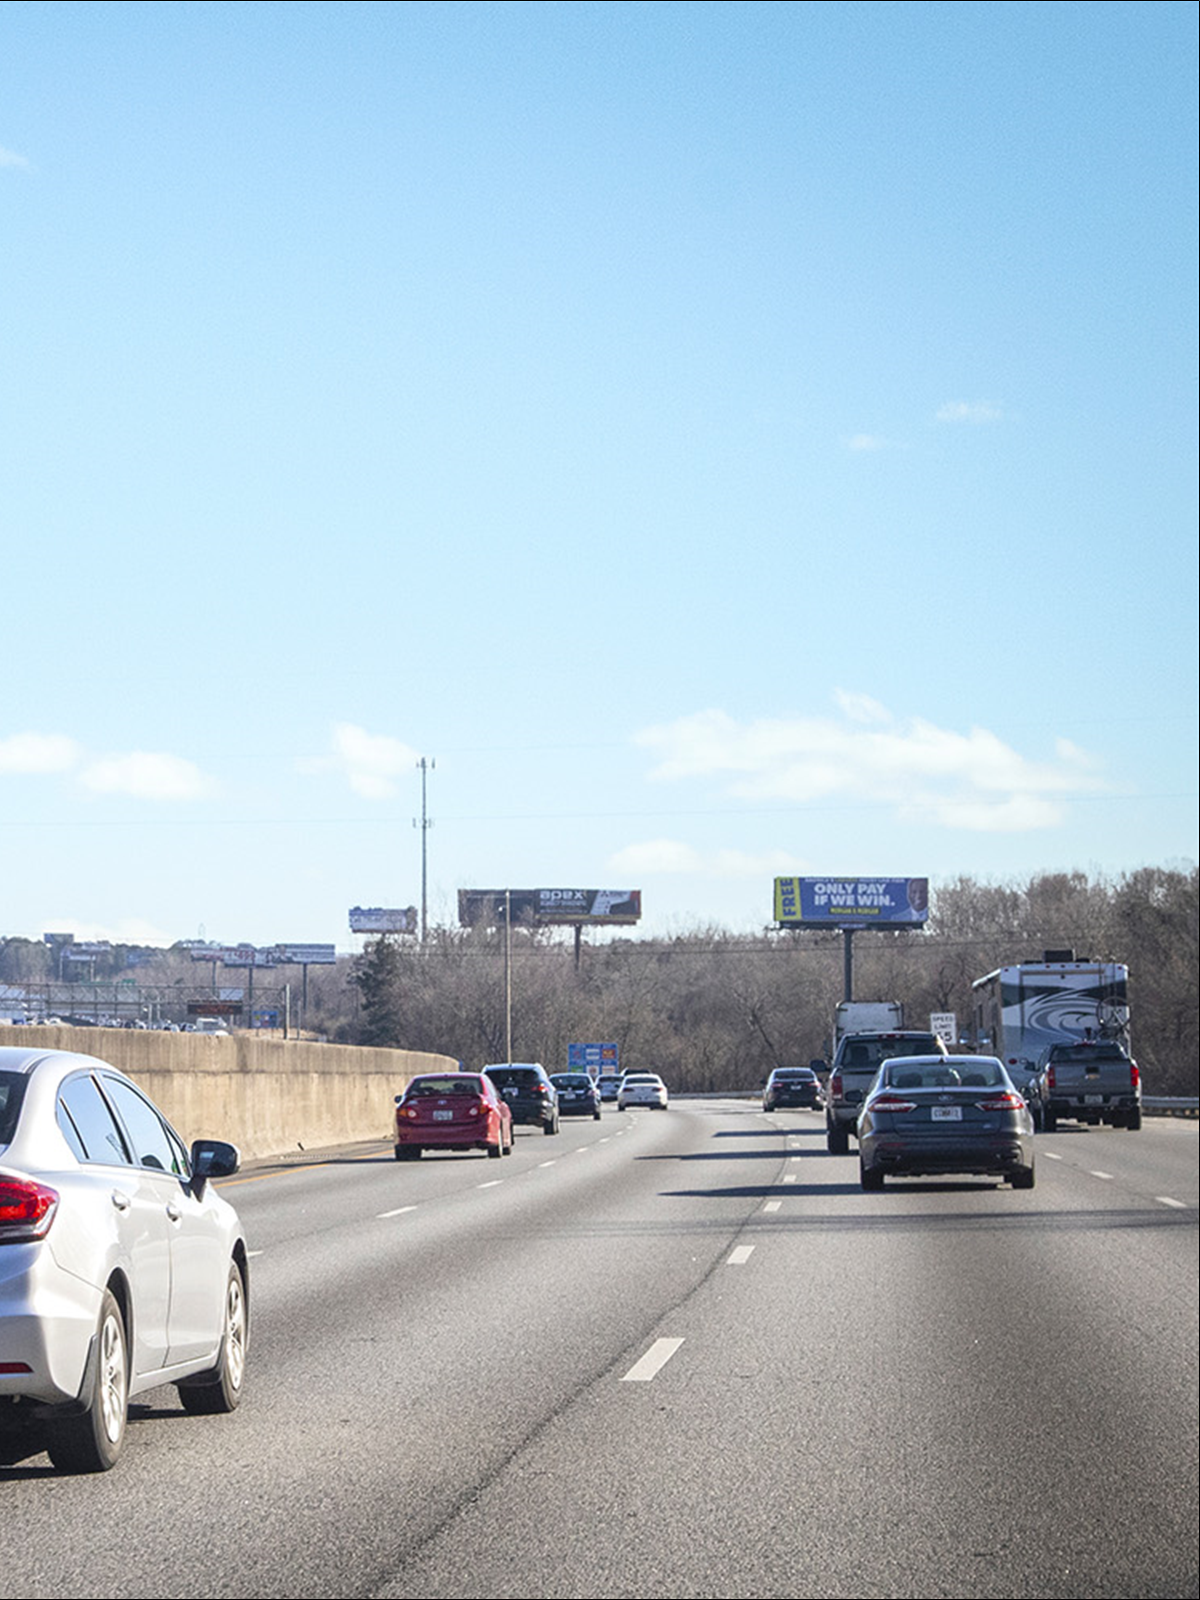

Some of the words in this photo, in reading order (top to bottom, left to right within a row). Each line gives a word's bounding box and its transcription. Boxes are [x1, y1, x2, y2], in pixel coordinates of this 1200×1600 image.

[814, 883, 855, 894] ONLY
[857, 883, 887, 894] PAY
[539, 890, 585, 902] apex
[780, 877, 797, 916] FREE
[814, 894, 829, 906] IF
[830, 894, 855, 906] WE
[857, 894, 896, 906] WIN.
